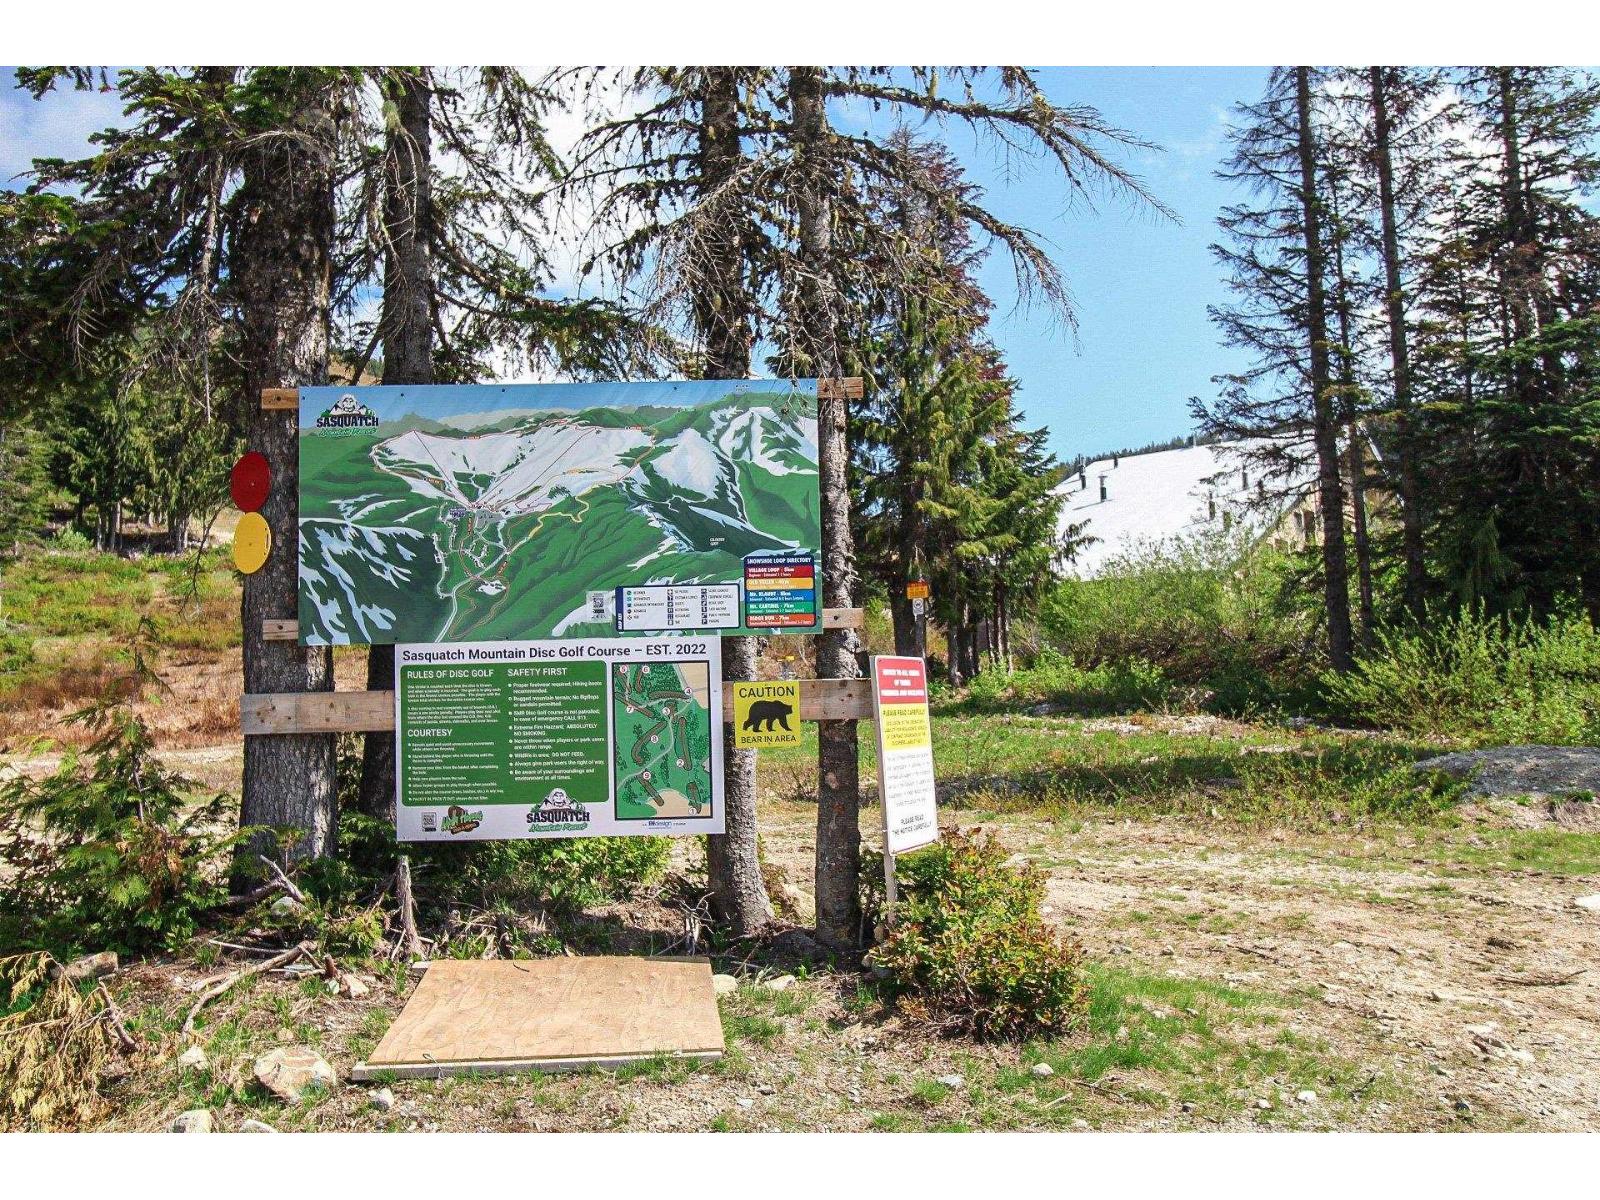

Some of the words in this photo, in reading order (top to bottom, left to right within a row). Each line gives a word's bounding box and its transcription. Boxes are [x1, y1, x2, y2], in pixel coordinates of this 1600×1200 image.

[316, 414, 378, 428] SASQUATCH
[403, 650, 466, 662] Sasquatch
[468, 648, 526, 660] Mountain
[530, 648, 556, 658] Disc
[559, 646, 584, 657] Golf
[588, 646, 630, 656] Course
[646, 644, 672, 655] EST.
[676, 644, 706, 654] 2022
[739, 686, 794, 698] CAUTION
[526, 810, 590, 823] SASQUATCH
